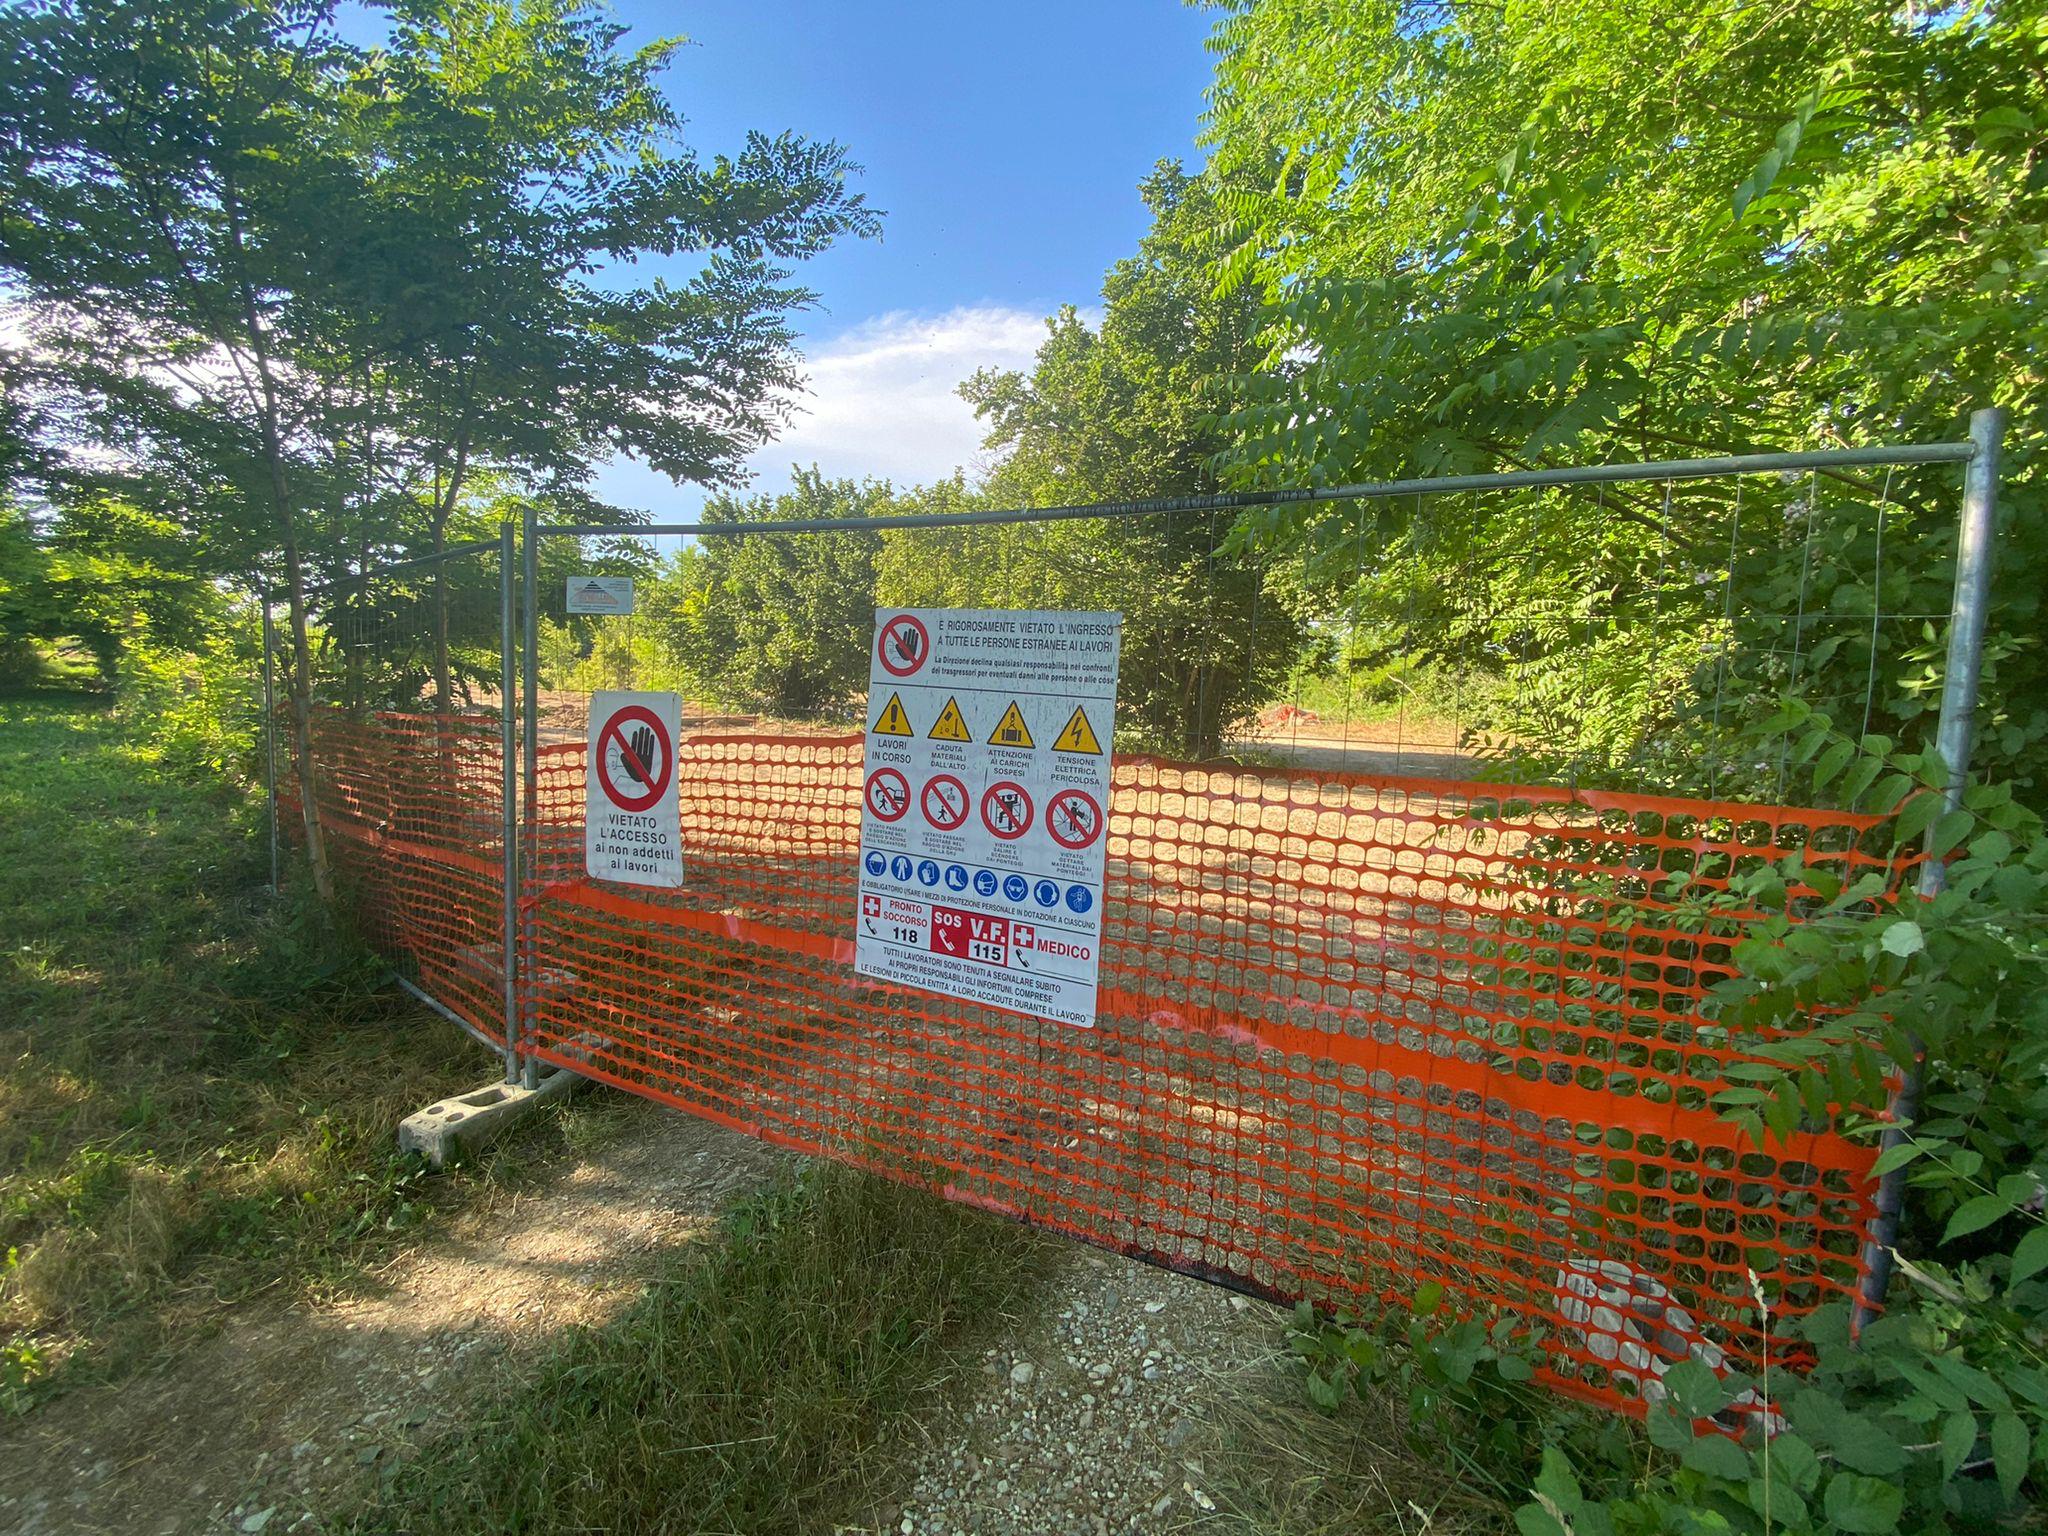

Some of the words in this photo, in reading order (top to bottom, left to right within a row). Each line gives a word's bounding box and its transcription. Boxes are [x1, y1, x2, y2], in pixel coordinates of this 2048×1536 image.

[948, 621, 1015, 633] RIGOROSAMENTE
[1020, 622, 1054, 634] VIETATO
[1060, 624, 1113, 636] L'INGRESSO
[937, 636, 943, 646] A
[945, 636, 968, 646] TUTTE
[970, 637, 980, 647] LE
[982, 637, 1020, 649] PERSONE
[1022, 638, 1067, 650] ESTRANEE
[1068, 640, 1078, 651] AI
[1080, 640, 1113, 652] LAVORI
[971, 658, 992, 666] declina
[994, 658, 1022, 668] qualsiasi
[1082, 664, 1113, 672] confronti
[942, 668, 976, 677] trasgressori
[988, 670, 1017, 678] eventuali
[1038, 672, 1049, 680] alle
[878, 739, 907, 750] LAVORI
[936, 744, 962, 752] CADUTA
[872, 751, 880, 760] IN
[882, 752, 912, 764] CORSO
[931, 752, 966, 762] MATERIALI
[988, 750, 1033, 760] ATTENZIONE
[1058, 756, 1096, 766] TENSIONE
[930, 761, 966, 770] DALL'ALTO
[1000, 759, 1030, 768] CARICHI
[1055, 765, 1097, 776] ELETTRICA
[994, 768, 1025, 777] SOSPESI
[1050, 774, 1100, 785] PERICOLOSA
[609, 814, 656, 828] VIETATO
[600, 828, 666, 844] L'ACCESSO
[596, 842, 604, 852] ai
[608, 845, 628, 856] non
[632, 847, 674, 860] addetti
[611, 858, 620, 869] ai
[625, 859, 657, 873] lavori
[866, 881, 903, 893] OBBLIGATORIO
[904, 889, 921, 897] USARE
[948, 896, 981, 908] PROTEZIONE
[982, 903, 1015, 915] PERSONALE
[1024, 910, 1057, 923] DOTAZIONE
[1064, 918, 1095, 930] CIASCUNO
[890, 900, 922, 914] PRONTO
[883, 911, 928, 927] SOCCORSO
[934, 911, 962, 928] SOS
[893, 927, 918, 943] 118
[970, 918, 1006, 943] V.F.
[974, 944, 1001, 960] 115
[1037, 938, 1090, 960] MEDICO
[884, 947, 899, 957] TUTTI
[904, 951, 942, 966] LAVORATORI
[944, 960, 962, 971] SONO
[963, 964, 986, 977] TENUTI
[987, 970, 992, 978] A
[993, 971, 1033, 987] SEGNALARE
[1036, 980, 1061, 994] SUBITO
[896, 960, 918, 972] PROPRI
[920, 966, 964, 982] RESPONSABILI
[965, 976, 976, 985] GLI
[1015, 988, 1053, 1003] COMPRESE
[861, 963, 868, 972] LE
[870, 966, 892, 978] LESIONI
[900, 972, 926, 985] PICCOLA
[958, 986, 976, 997] LORO
[977, 992, 1013, 1006] ACCADUTE
[1015, 1000, 1046, 1014] DURANTE
[1048, 1007, 1054, 1016] IL
[1056, 1008, 1086, 1023] LAVORO
